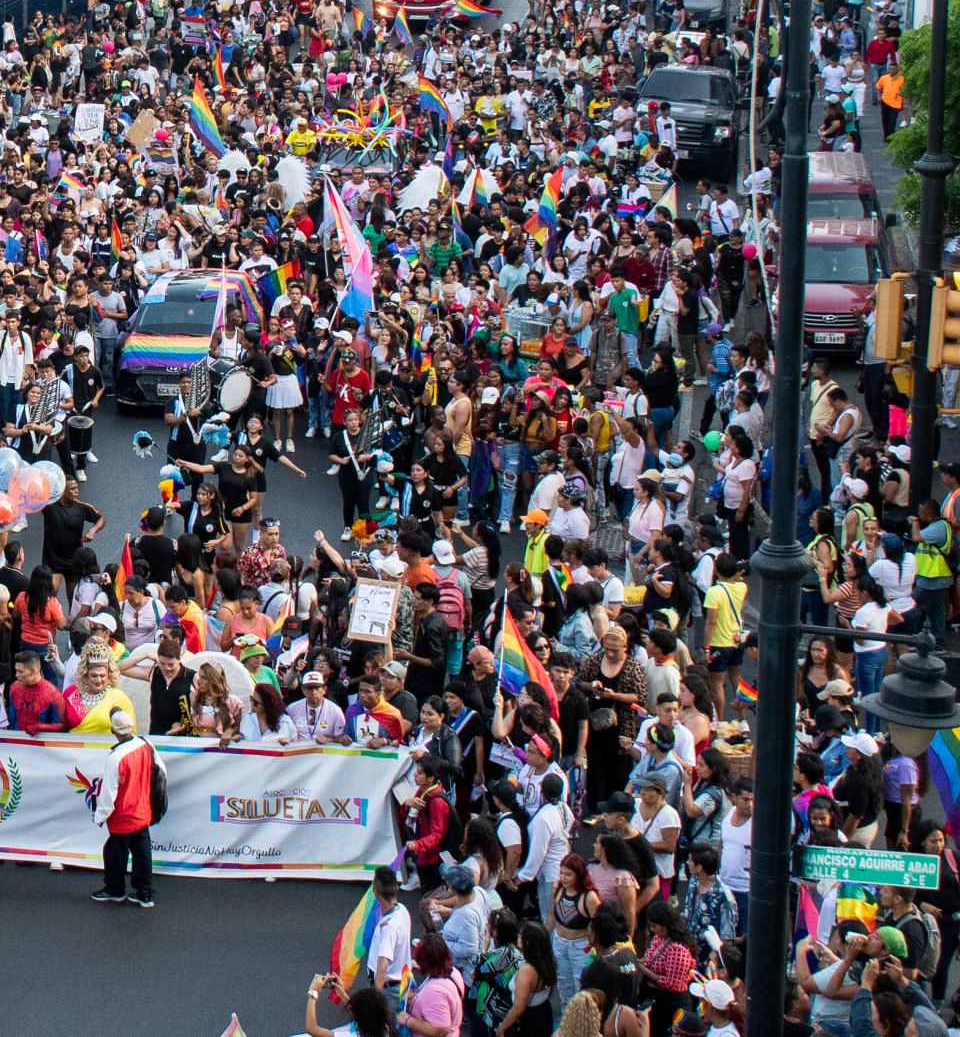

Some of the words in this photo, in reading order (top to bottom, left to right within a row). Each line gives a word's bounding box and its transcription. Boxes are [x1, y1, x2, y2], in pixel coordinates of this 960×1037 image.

[226, 797, 326, 819] SILUETA
[802, 852, 857, 869] RANCISCO
[859, 857, 905, 871] AGUIRRE
[907, 861, 937, 874] ABAD
[805, 865, 837, 878] CALLE
[842, 870, 849, 879] 4
